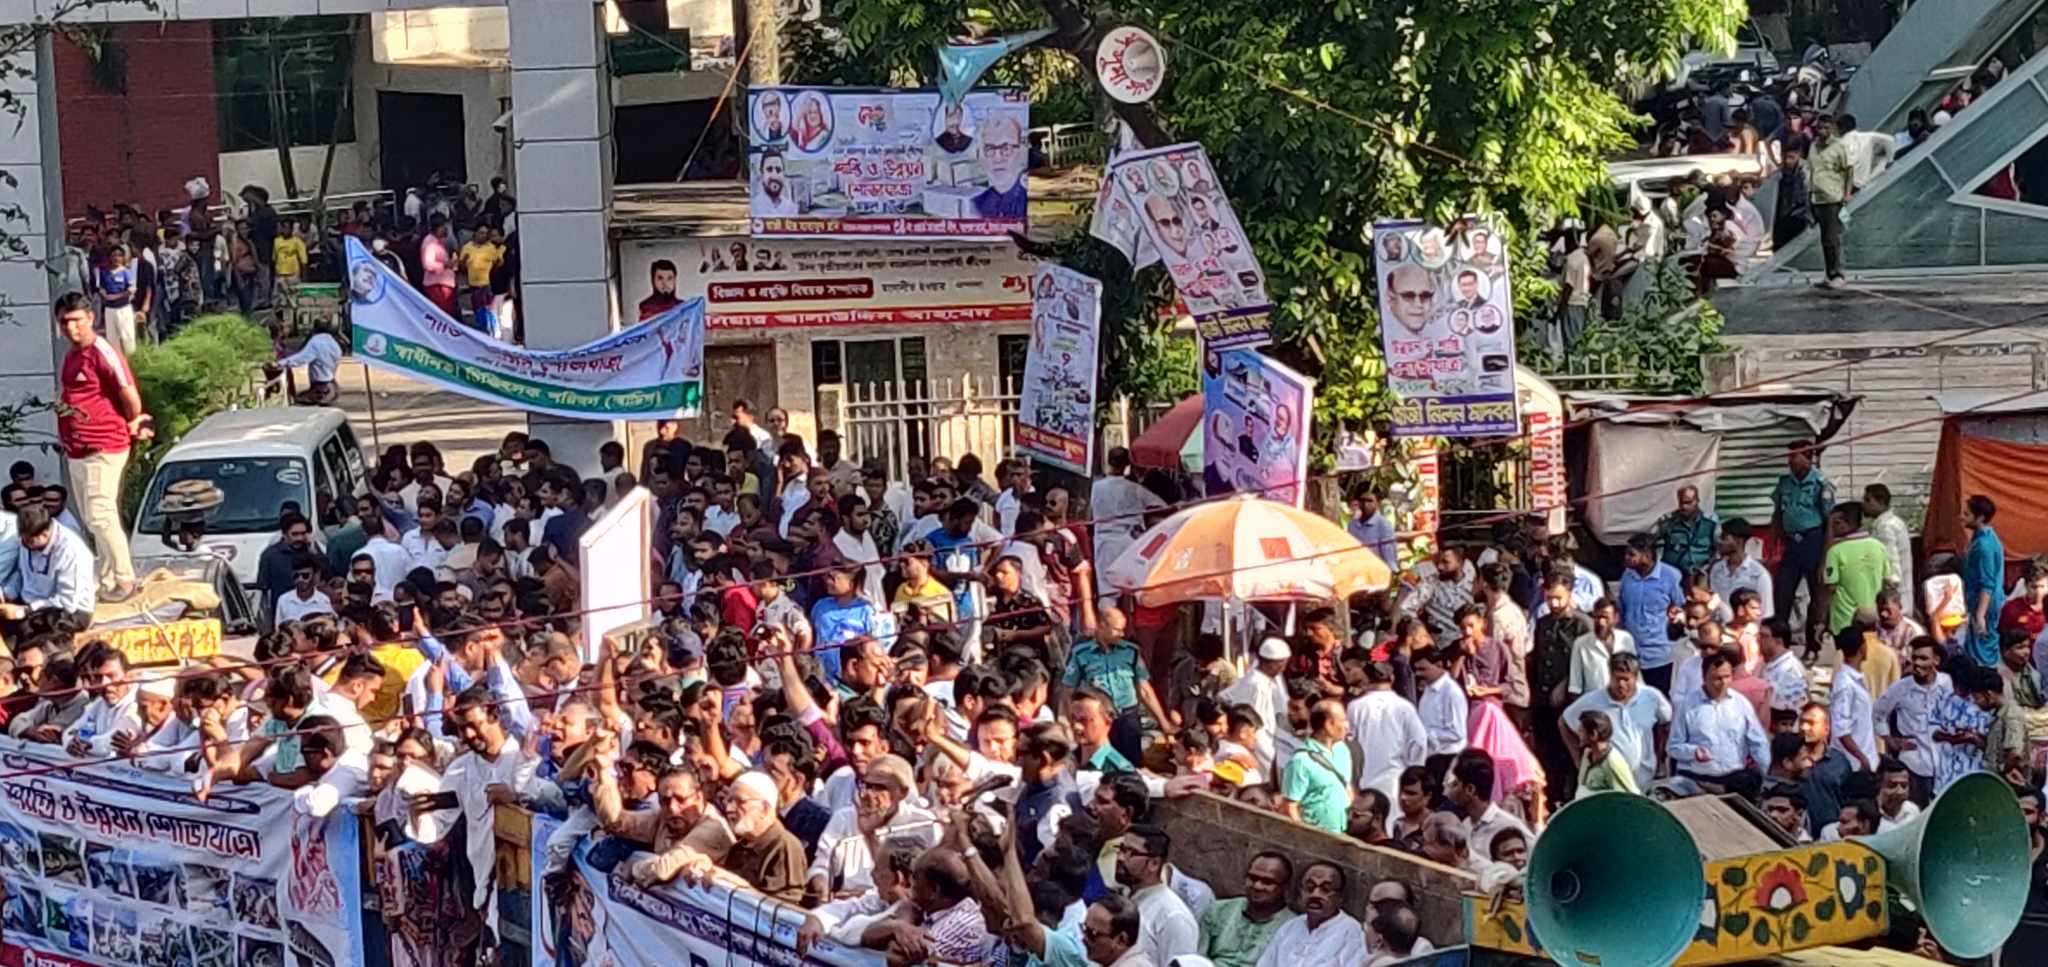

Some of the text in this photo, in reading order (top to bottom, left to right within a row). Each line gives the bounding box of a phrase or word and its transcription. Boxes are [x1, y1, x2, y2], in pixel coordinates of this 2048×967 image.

[747, 286, 757, 297] ও
[3, 778, 57, 821] শান্তি
[60, 795, 76, 821] ও
[74, 790, 144, 835] উন্নয়ন
[145, 811, 261, 858] শোভাযাত্রা
